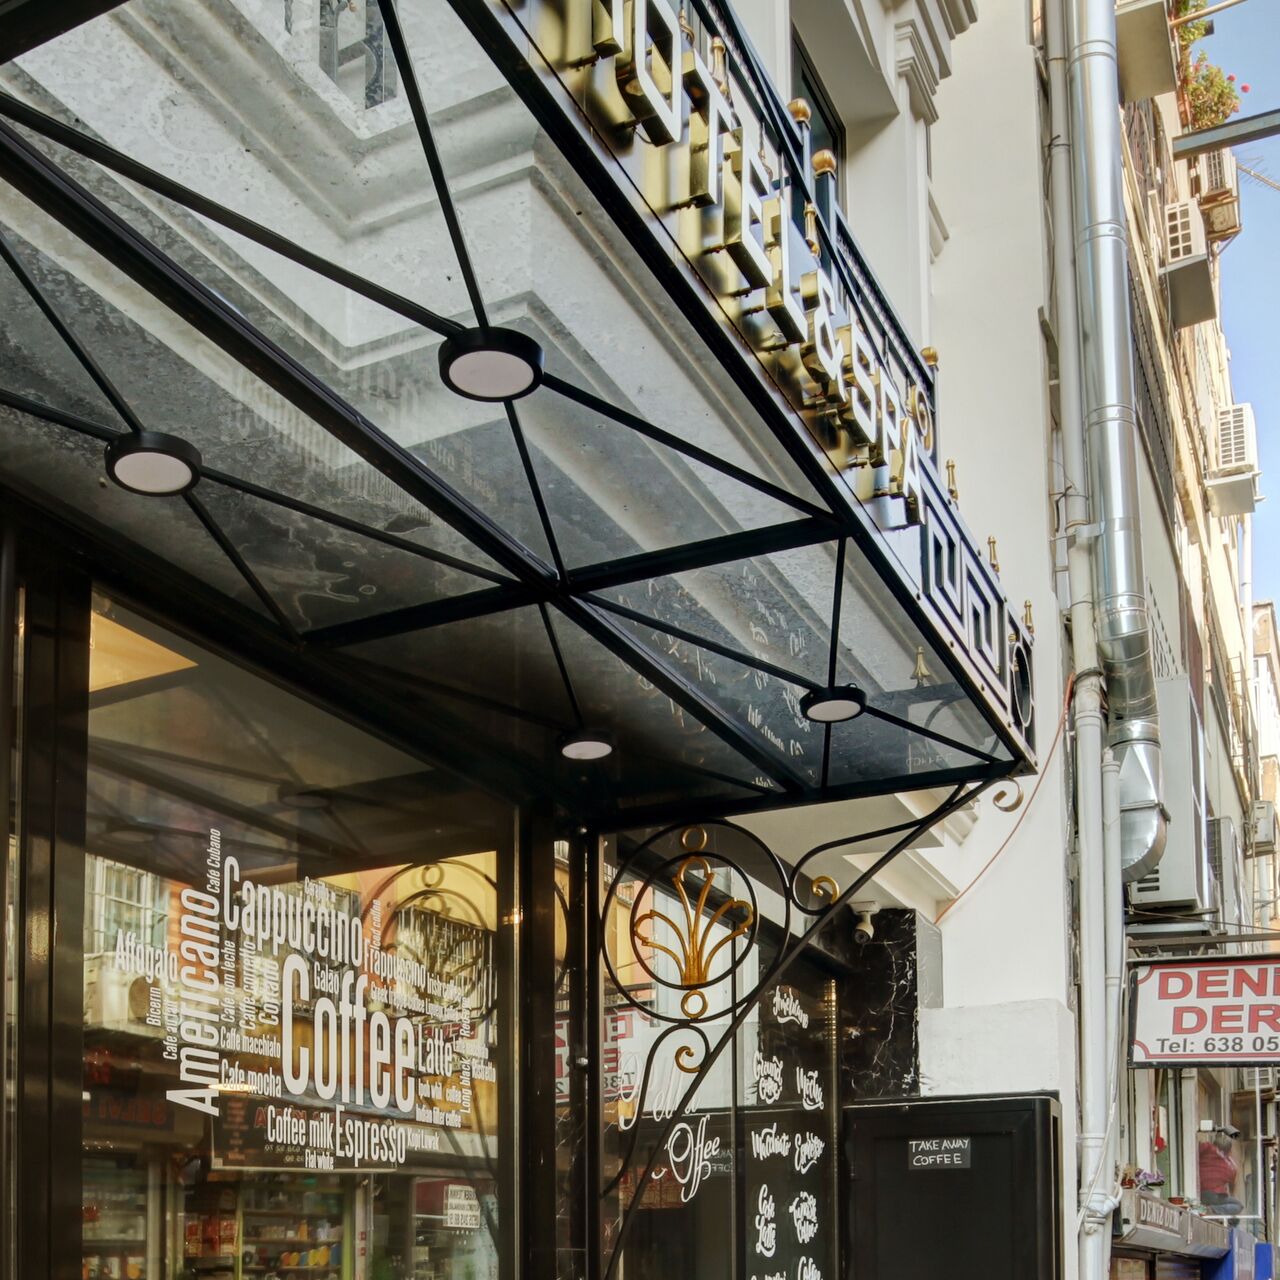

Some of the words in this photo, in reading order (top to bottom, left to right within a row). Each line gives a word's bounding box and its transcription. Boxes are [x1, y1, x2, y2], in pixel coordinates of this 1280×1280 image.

[849, 318, 927, 528] SPA
[206, 828, 221, 868] Cubano
[224, 855, 363, 967] Cappuccino
[115, 928, 178, 987] Affogato
[221, 940, 236, 970] leche
[239, 940, 256, 993] corretto
[223, 971, 236, 995] con
[313, 961, 340, 995] Galão
[146, 986, 161, 1027] Bicerin
[166, 888, 220, 1117] Americano
[242, 1034, 281, 1060] macchiato
[282, 953, 416, 1114] Coffee
[418, 1022, 453, 1077] Latte
[1156, 1037, 1195, 1053] Tel:
[1204, 1036, 1243, 1052] 638
[1252, 1035, 1279, 1051] 05
[247, 1066, 282, 1098] mocha
[460, 1056, 471, 1086] black
[460, 1086, 472, 1114] Long
[267, 1104, 306, 1146] Coffee
[309, 1111, 334, 1150] milk
[335, 1103, 406, 1168] Espresso
[909, 1140, 939, 1152] TAKE
[942, 1138, 969, 1150] AWAY
[305, 1149, 317, 1169] Flat
[317, 1153, 334, 1171] white
[913, 1153, 962, 1165] COFFEE
